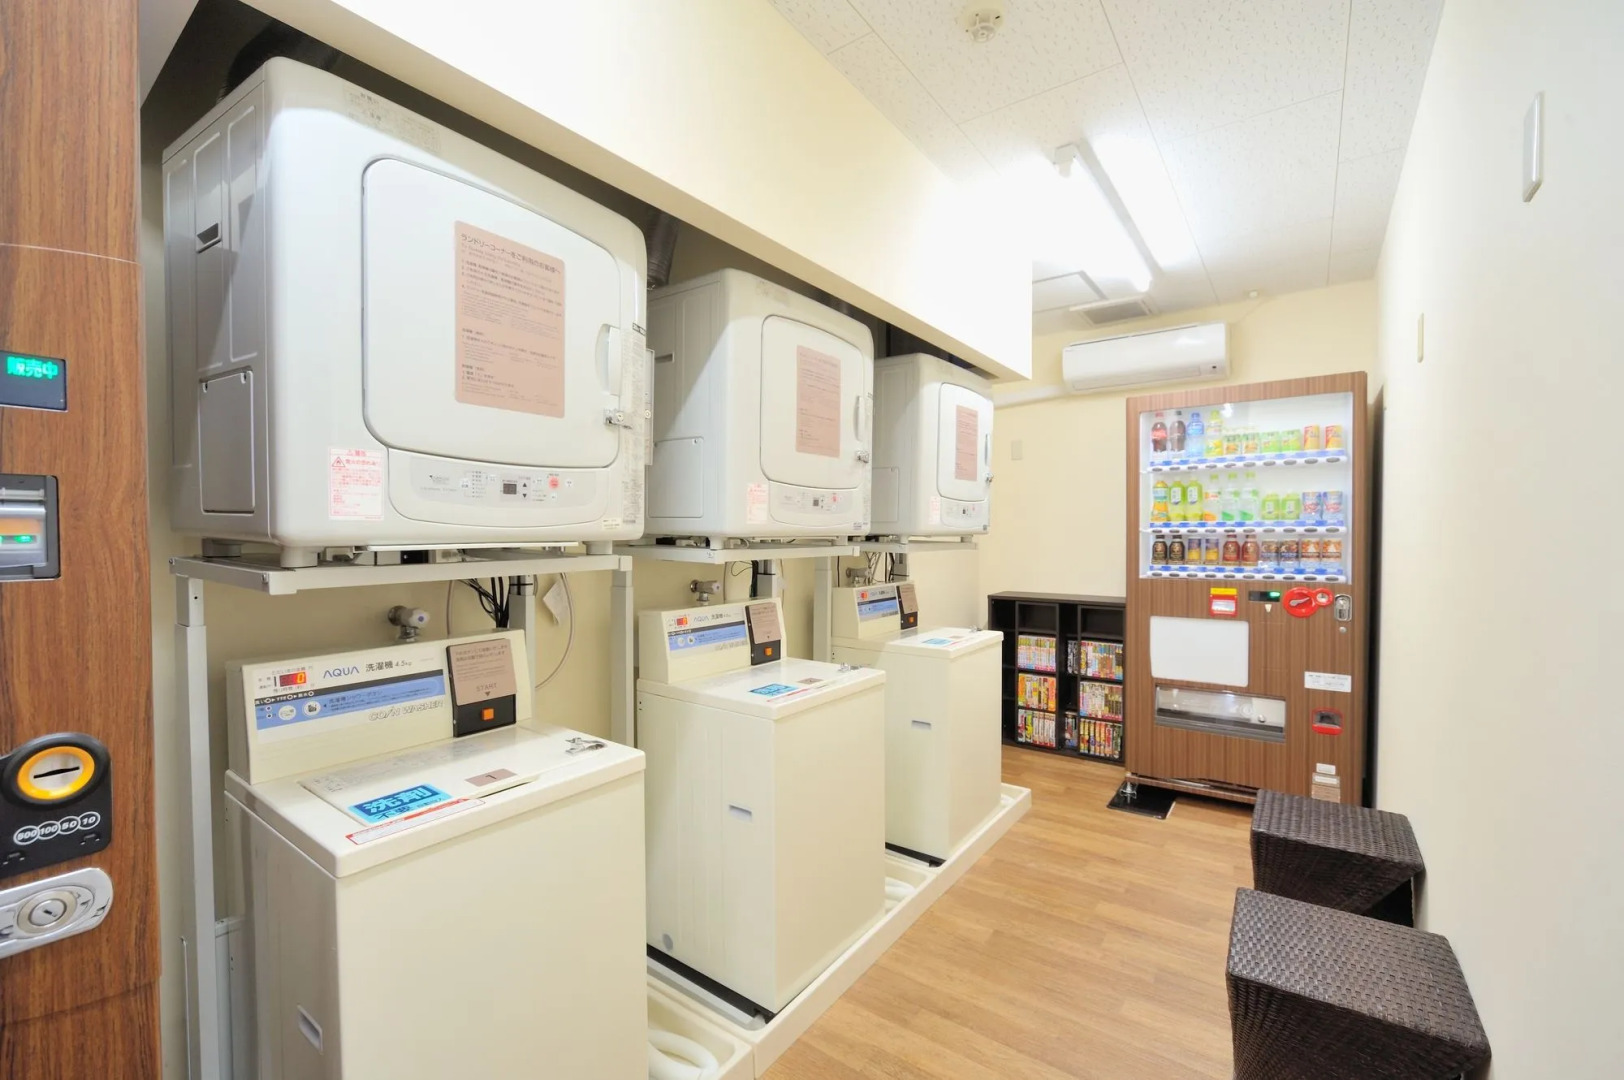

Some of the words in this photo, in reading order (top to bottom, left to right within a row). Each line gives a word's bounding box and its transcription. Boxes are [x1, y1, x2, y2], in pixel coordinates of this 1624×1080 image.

[297, 672, 305, 684] 0
[323, 666, 360, 679] AQUA
[365, 660, 394, 673] 洗濯機
[368, 706, 401, 721] COIN
[401, 701, 444, 715] WASHER
[362, 785, 434, 813] 洗剤
[17, 830, 38, 840] 500
[40, 824, 58, 836] 100
[61, 821, 77, 829] 50
[82, 816, 96, 825] 10
